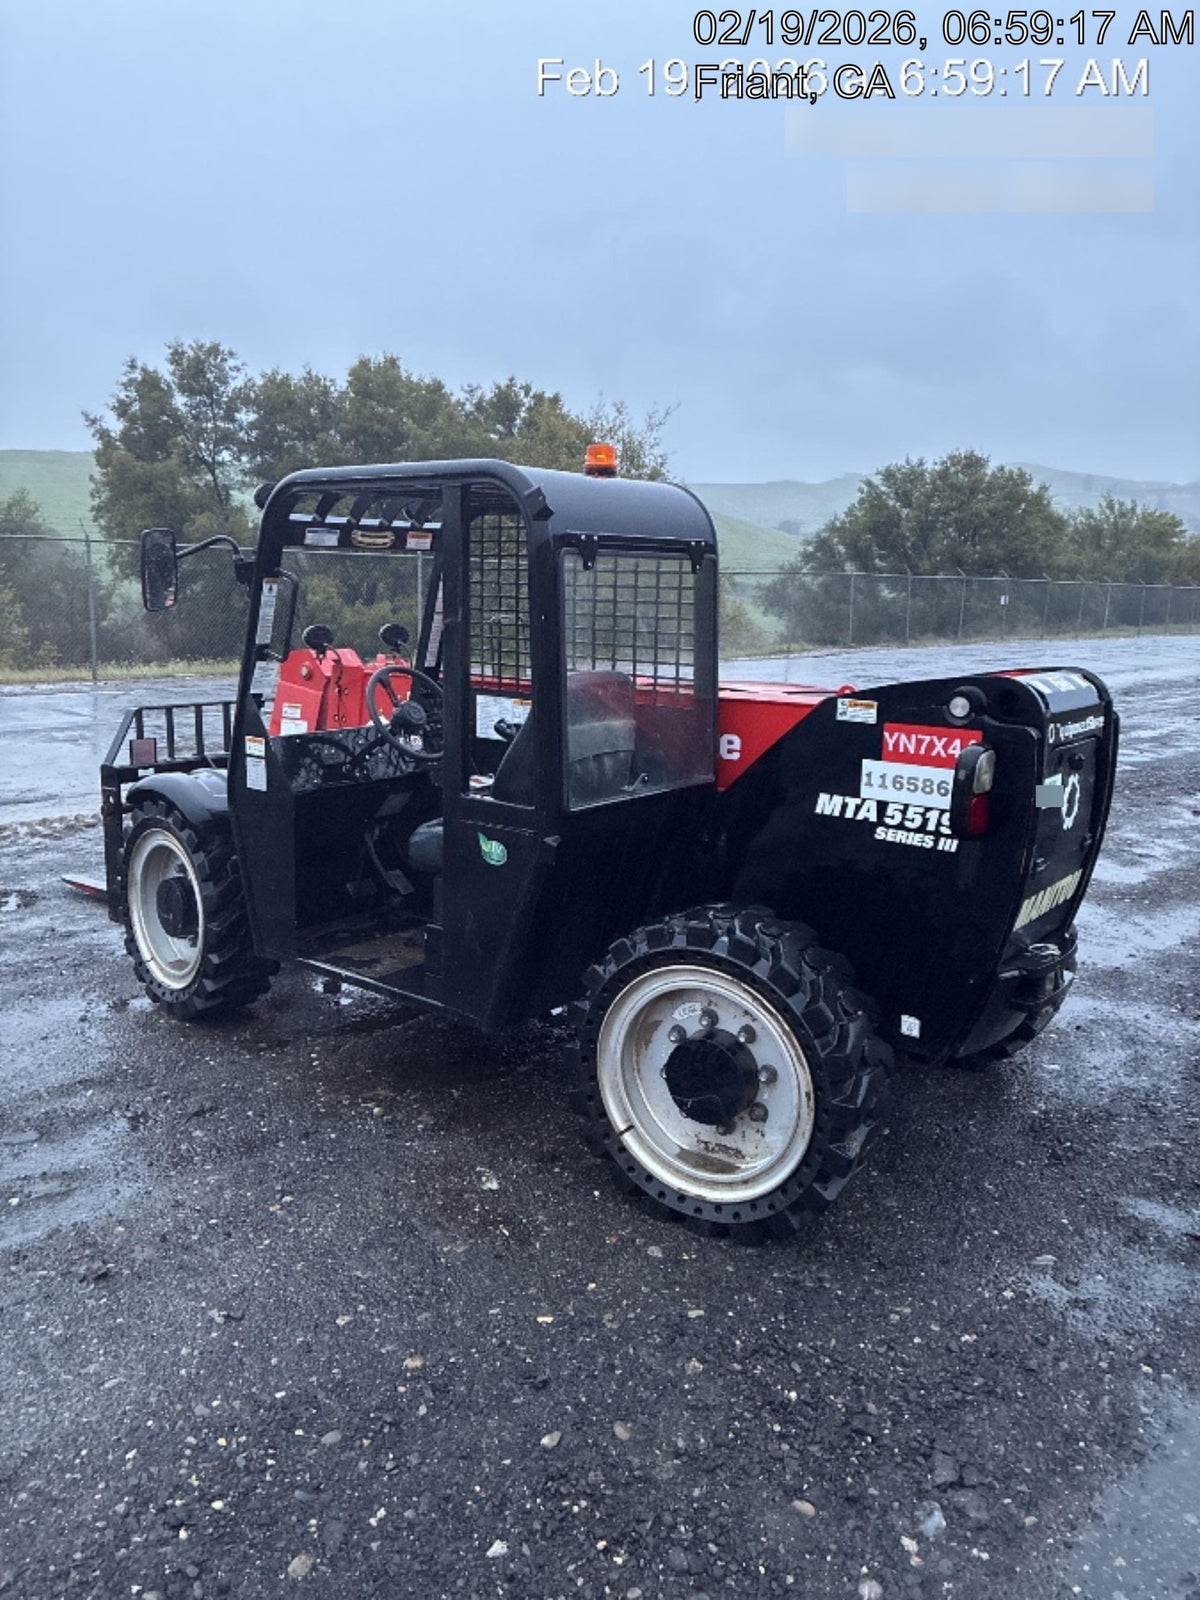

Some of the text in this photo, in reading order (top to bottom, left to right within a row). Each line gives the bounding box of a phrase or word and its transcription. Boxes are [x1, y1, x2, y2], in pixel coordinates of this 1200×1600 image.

[883, 731, 979, 759] YN7X4
[864, 771, 951, 797] 116586
[814, 792, 878, 822] MTA
[874, 826, 960, 853] SERIES III
